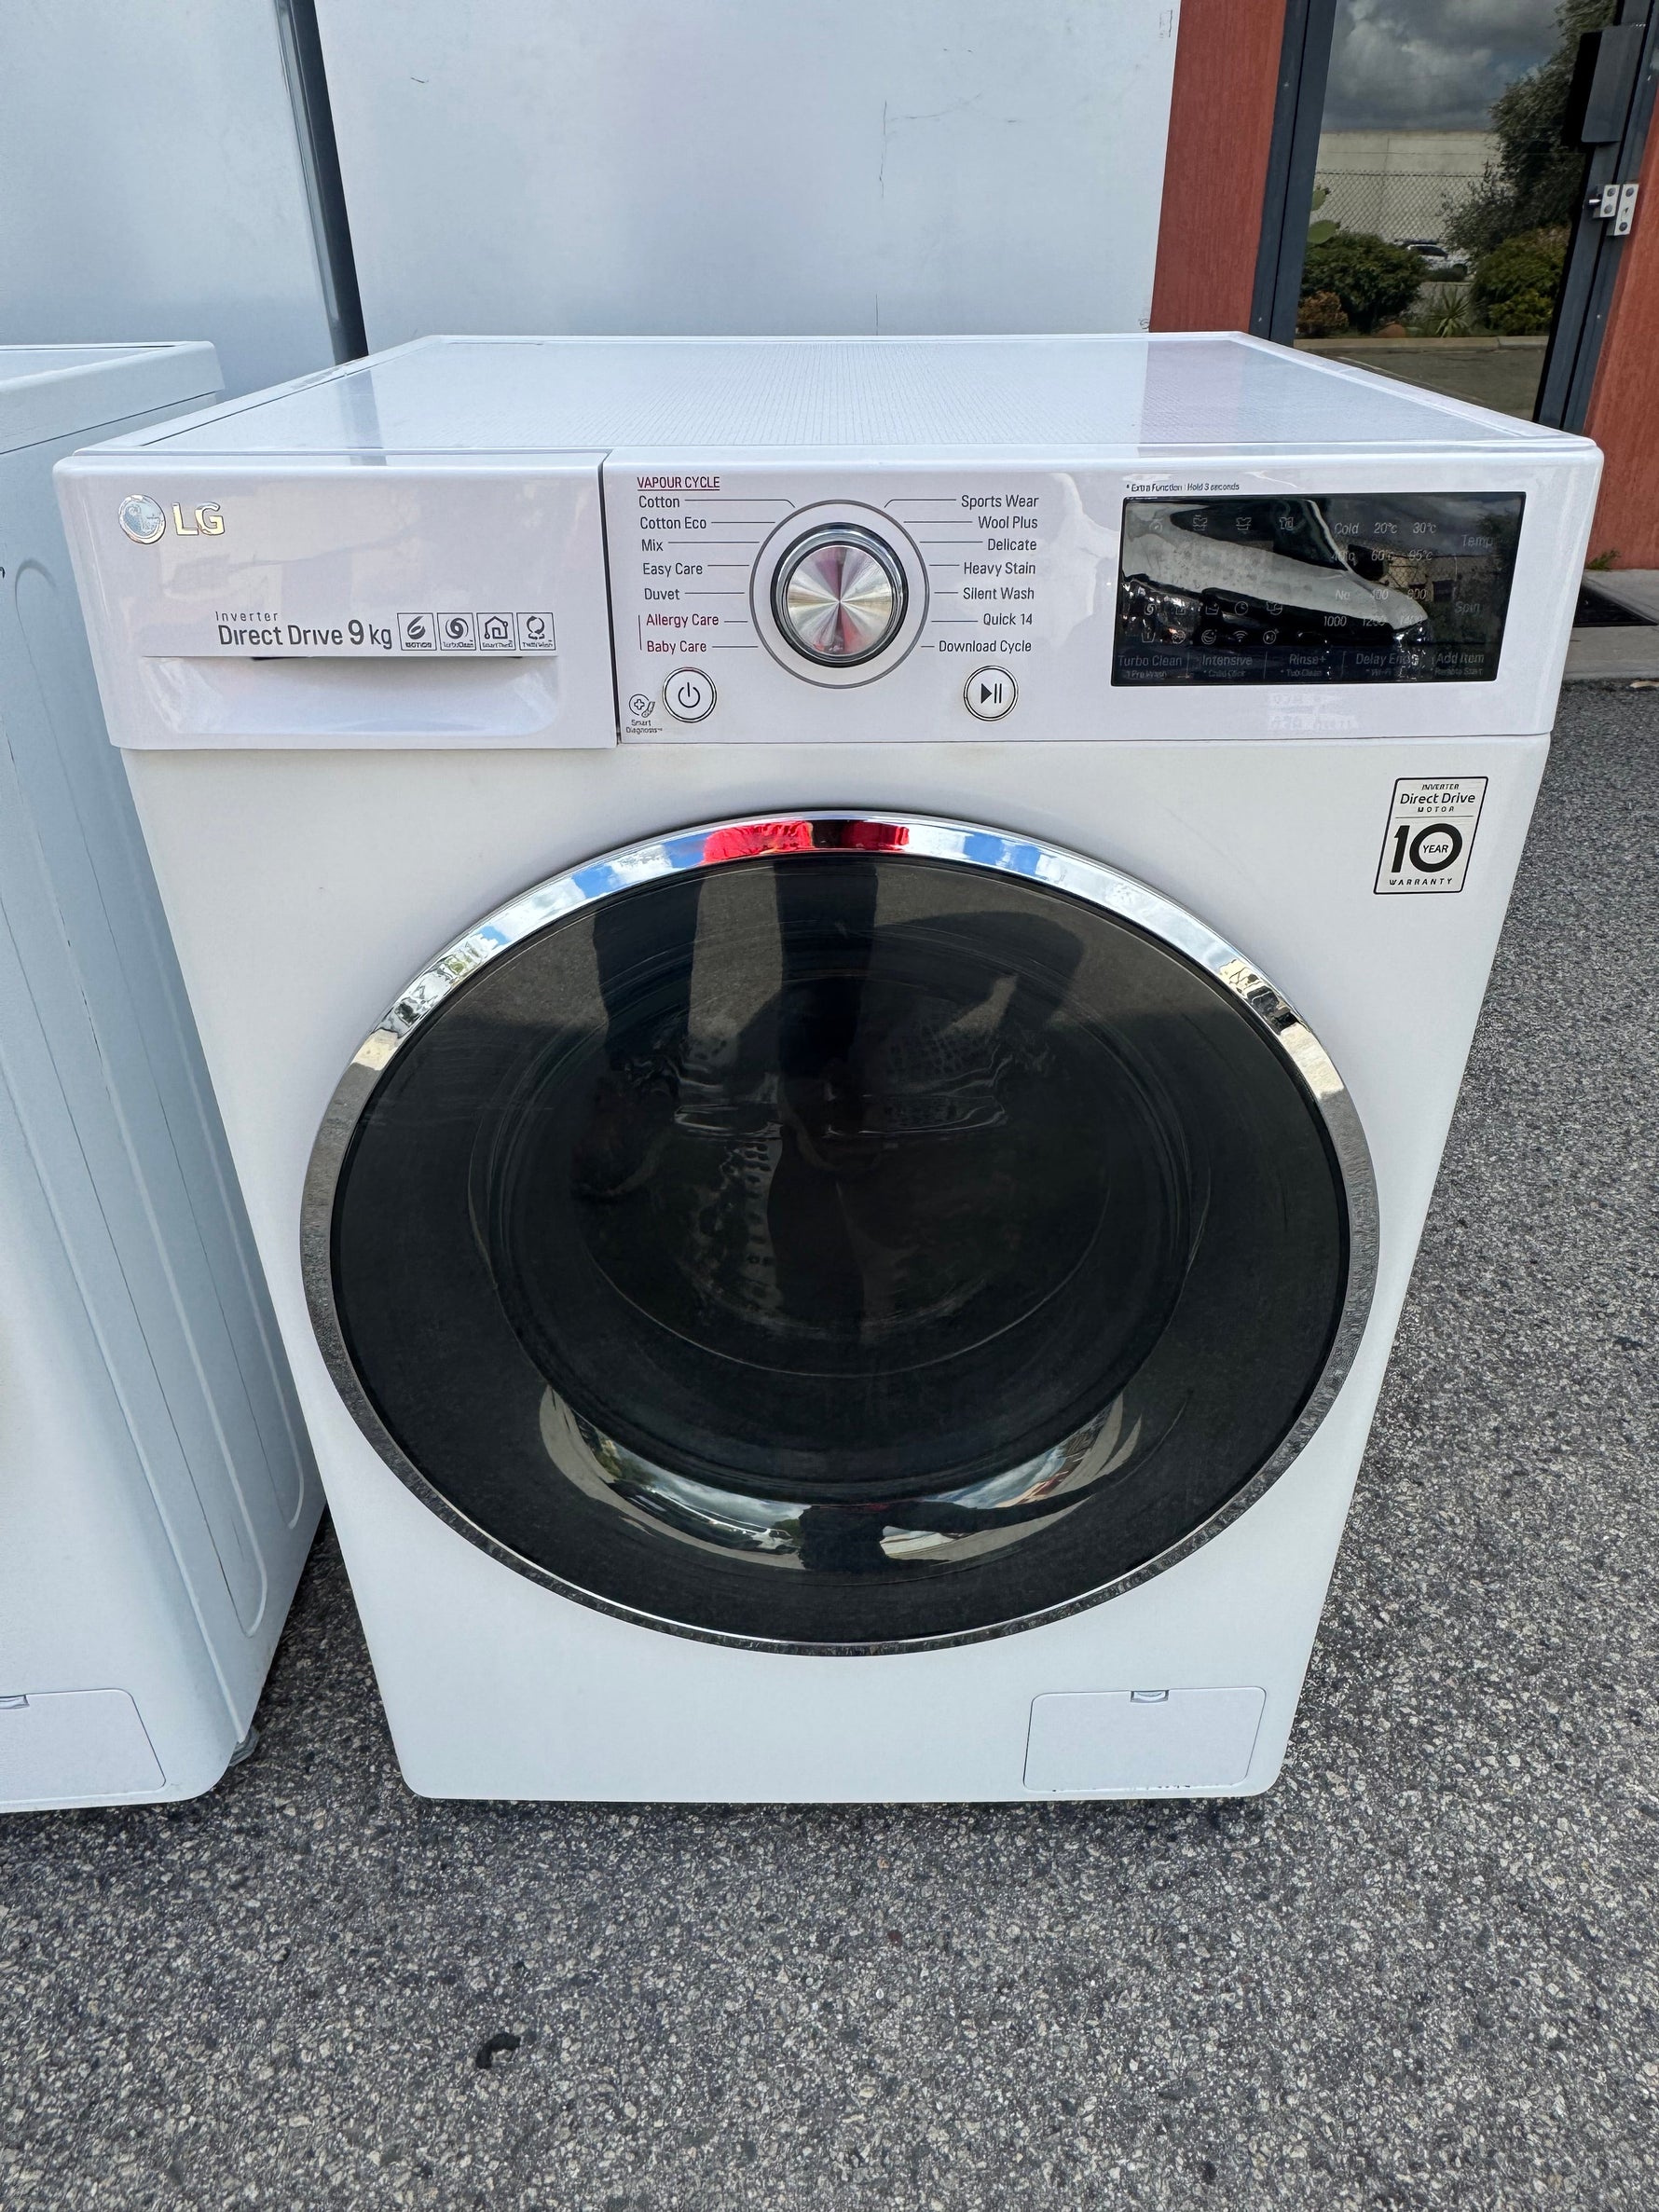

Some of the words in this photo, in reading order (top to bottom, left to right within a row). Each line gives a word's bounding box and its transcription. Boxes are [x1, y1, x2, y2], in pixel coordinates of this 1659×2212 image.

[637, 476, 682, 488] VAPOUR
[684, 476, 720, 488] CYCLE
[1186, 482, 1203, 491] Hold
[1210, 482, 1240, 491] seconds
[638, 495, 680, 508] Cotton
[961, 495, 1002, 510] Sports
[1006, 495, 1039, 508] Wear
[172, 502, 225, 536] LG
[639, 516, 681, 529] Cotton
[685, 516, 706, 529] Eco
[978, 515, 1009, 529] Wool
[1012, 515, 1038, 529] Plus
[1334, 522, 1360, 534] Cold
[641, 539, 664, 552] Mix
[987, 538, 1037, 551] Delicate
[642, 562, 671, 577] Easy
[675, 562, 703, 575] Care
[964, 562, 1002, 577] Heavy
[1005, 561, 1036, 574] Stain
[644, 587, 679, 600] Duvet
[963, 587, 997, 599] Silent
[1000, 587, 1035, 599] Wash
[1455, 600, 1481, 614] Spin
[215, 611, 279, 623] Inverter
[646, 613, 688, 628] Allergy
[692, 613, 719, 625] Care
[982, 612, 1016, 626] Quick
[1021, 612, 1033, 625] 14
[1323, 615, 1348, 626] 1000
[218, 624, 282, 647] Direct
[288, 624, 343, 646] Drive
[647, 640, 677, 654] Baby
[679, 640, 706, 653] Care
[939, 640, 996, 653] Download
[1000, 640, 1032, 654] Cycle
[1119, 655, 1149, 666] Turbo
[1152, 655, 1182, 666] Clean
[1202, 655, 1253, 666] Intensive
[1356, 653, 1386, 666] Delay
[1436, 653, 1458, 664] Add
[1400, 793, 1438, 804] Direct
[1441, 792, 1475, 804] Drive
[1391, 822, 1463, 873] 10
[1422, 845, 1449, 854] YEAR
[1389, 877, 1453, 886] WARRANTY
